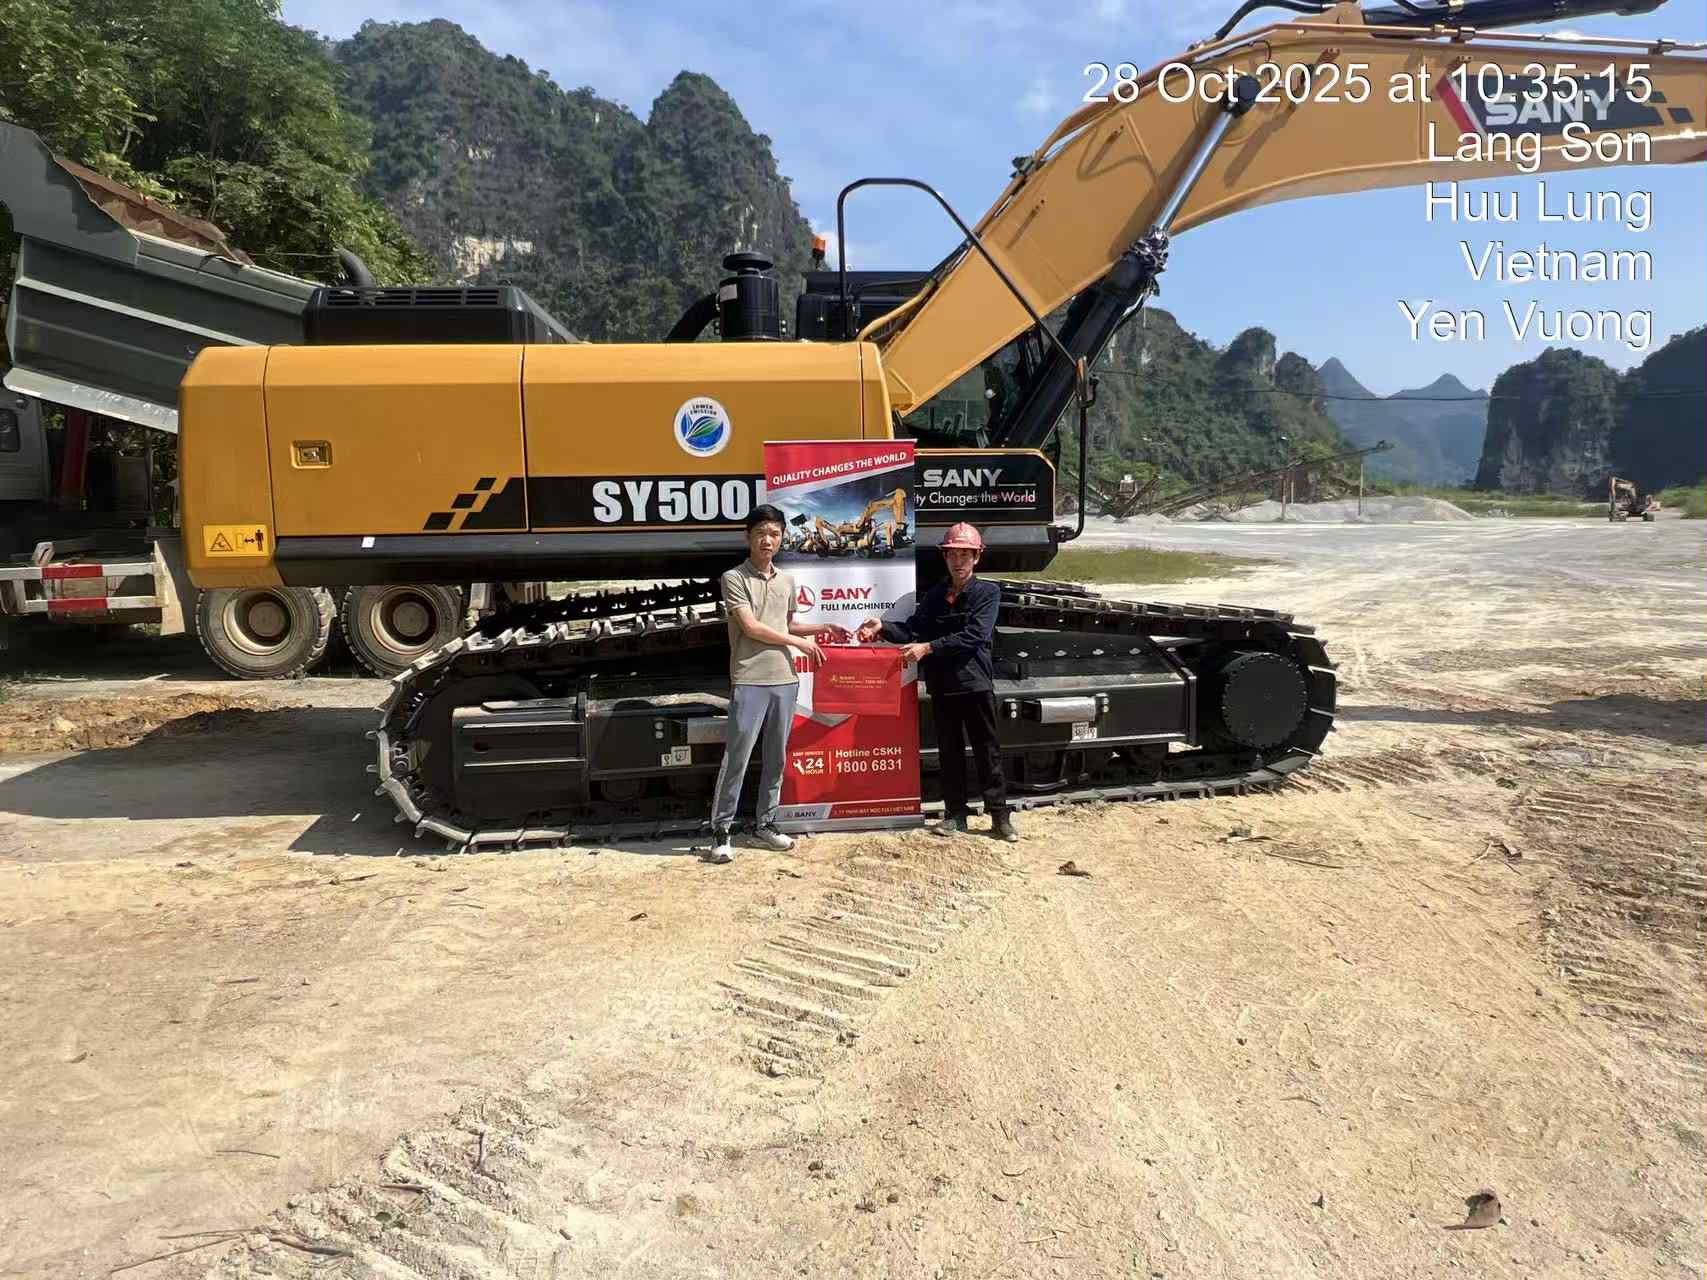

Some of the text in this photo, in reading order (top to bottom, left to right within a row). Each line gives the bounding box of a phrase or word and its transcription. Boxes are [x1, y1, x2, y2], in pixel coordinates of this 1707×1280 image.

[1485, 89, 1619, 126] SANY
[772, 451, 907, 485] QUALITY CHANGES THE WORLD
[922, 468, 1003, 488] SANY
[929, 491, 978, 507] Changes
[981, 490, 998, 503] the
[1000, 489, 1036, 503] World
[820, 587, 873, 600] SANY
[842, 602, 896, 611] MACHINERY
[835, 749, 870, 759] Hotline
[872, 746, 902, 757] CSKH
[805, 758, 824, 769] 24
[836, 758, 902, 774] 1800 6831
